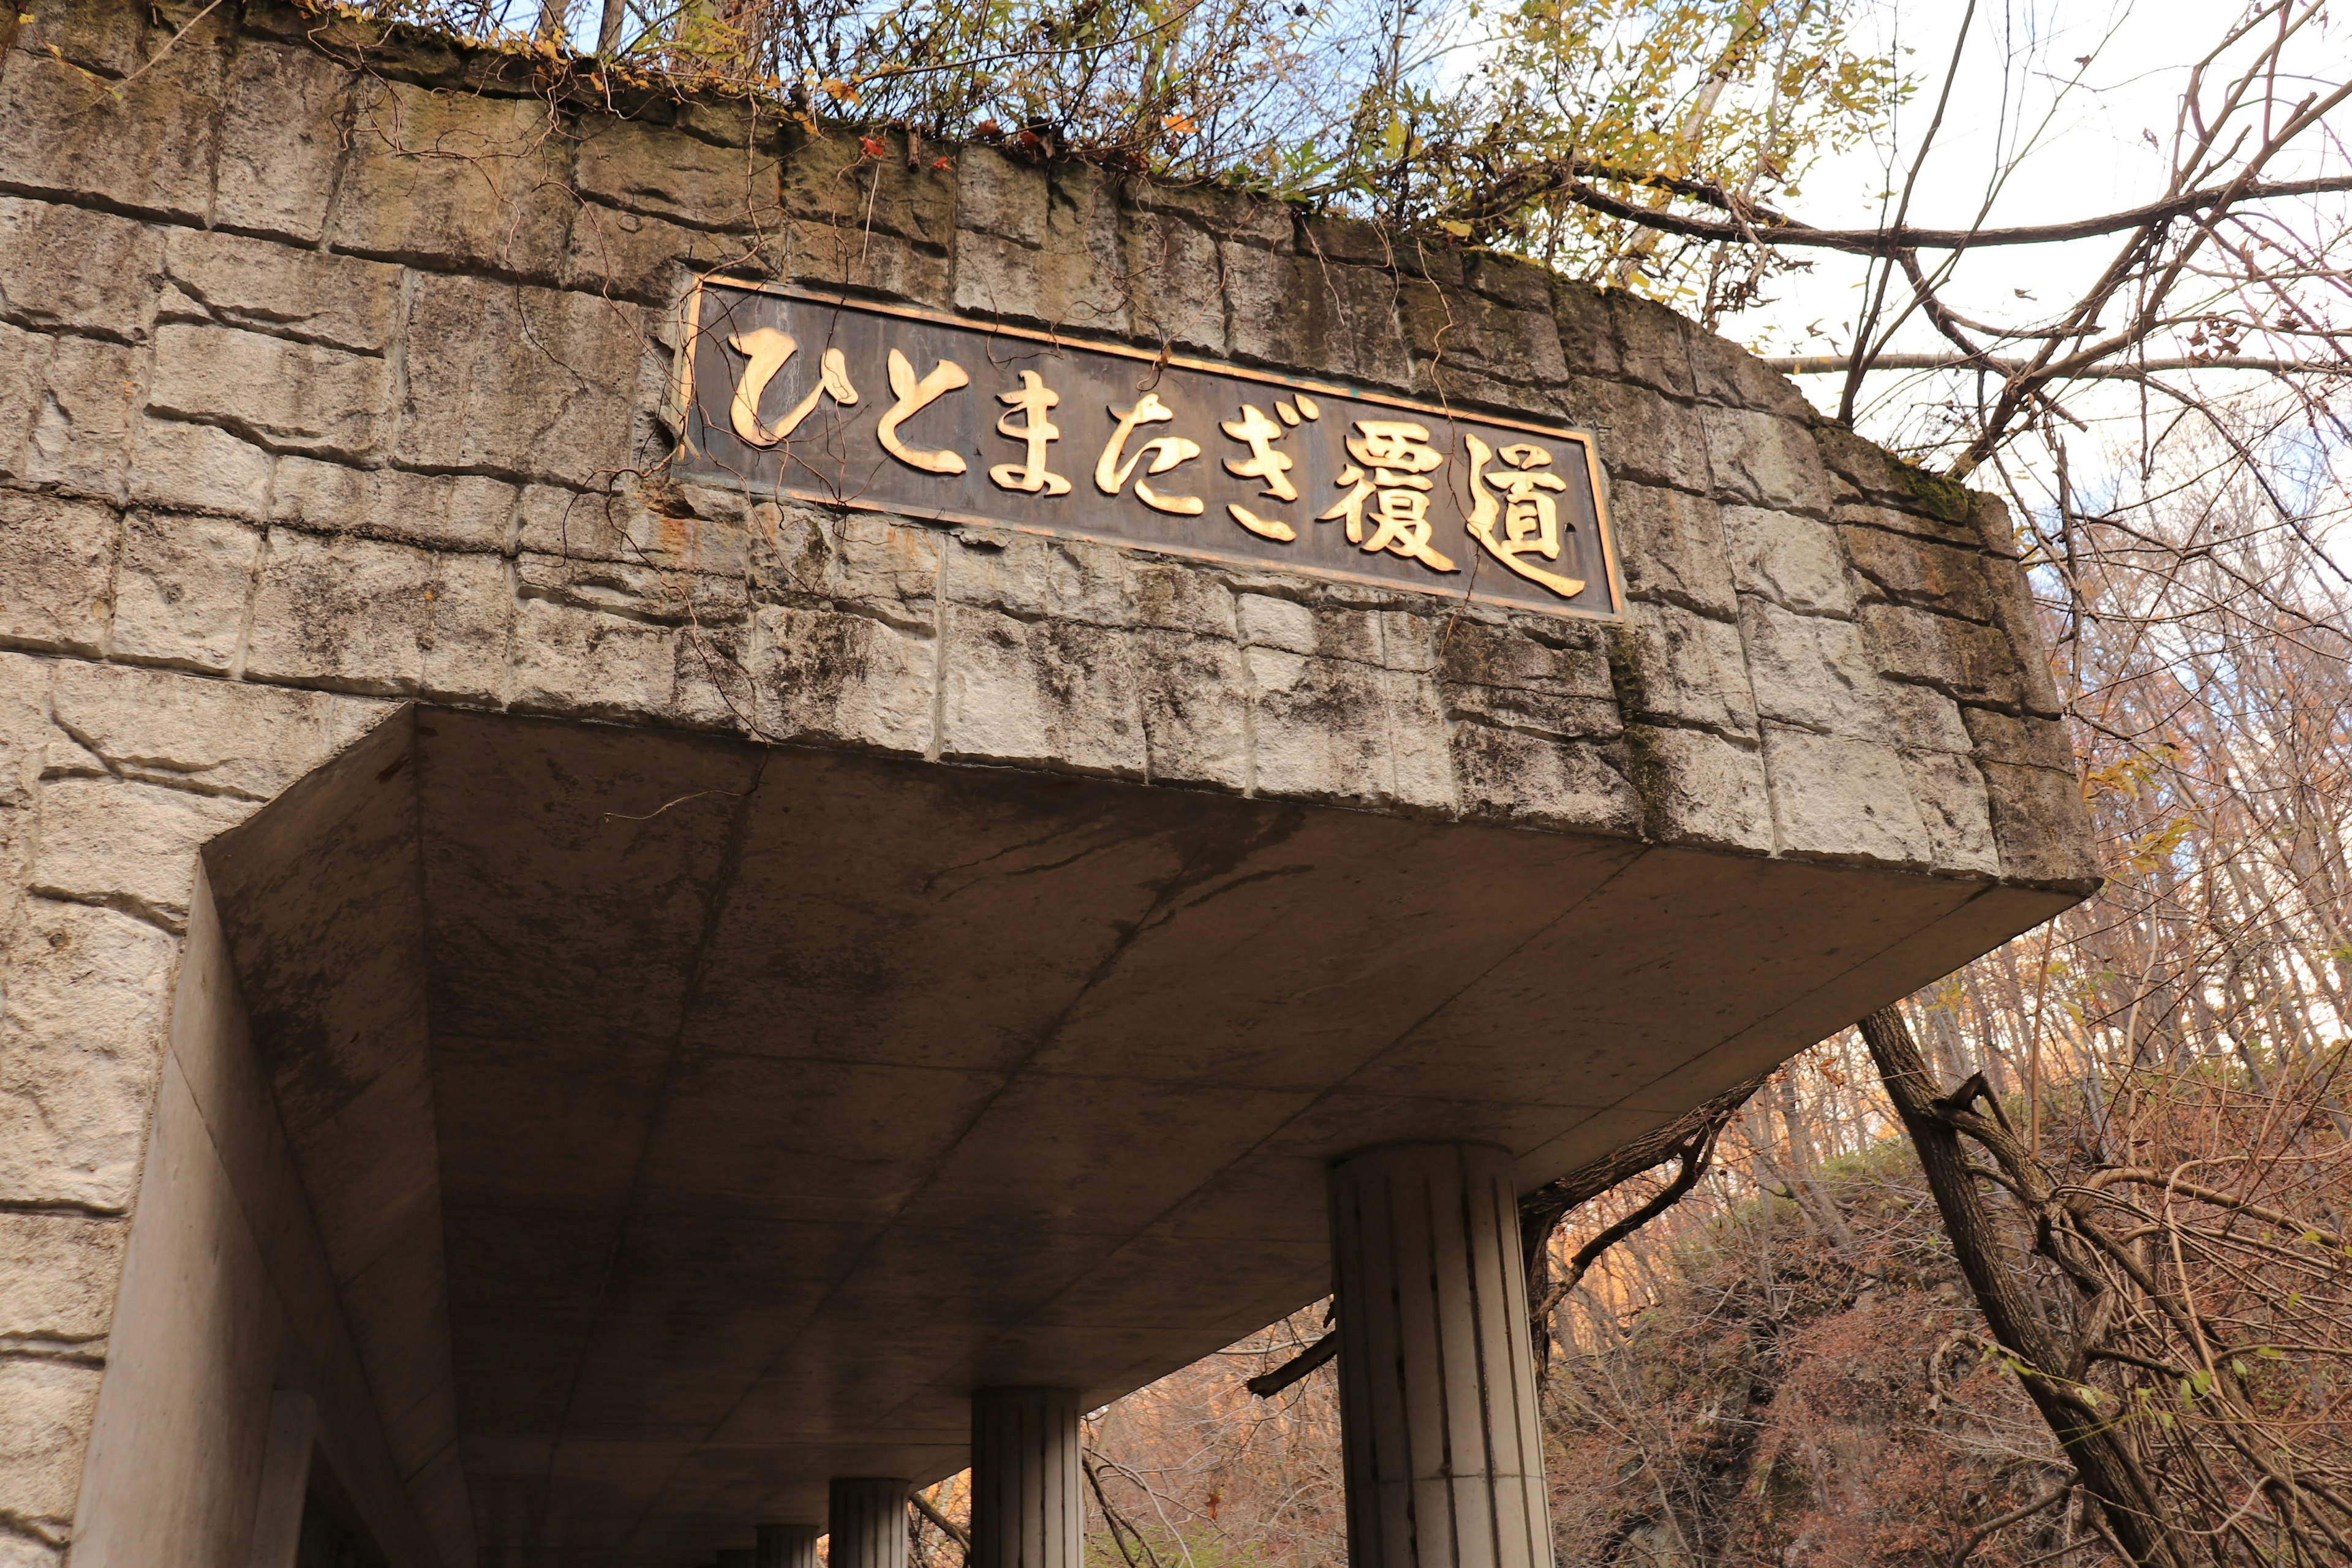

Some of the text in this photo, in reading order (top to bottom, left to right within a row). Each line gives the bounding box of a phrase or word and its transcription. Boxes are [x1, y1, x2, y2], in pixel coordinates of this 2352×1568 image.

[728, 327, 1585, 597] ひとまたぎ覆道
